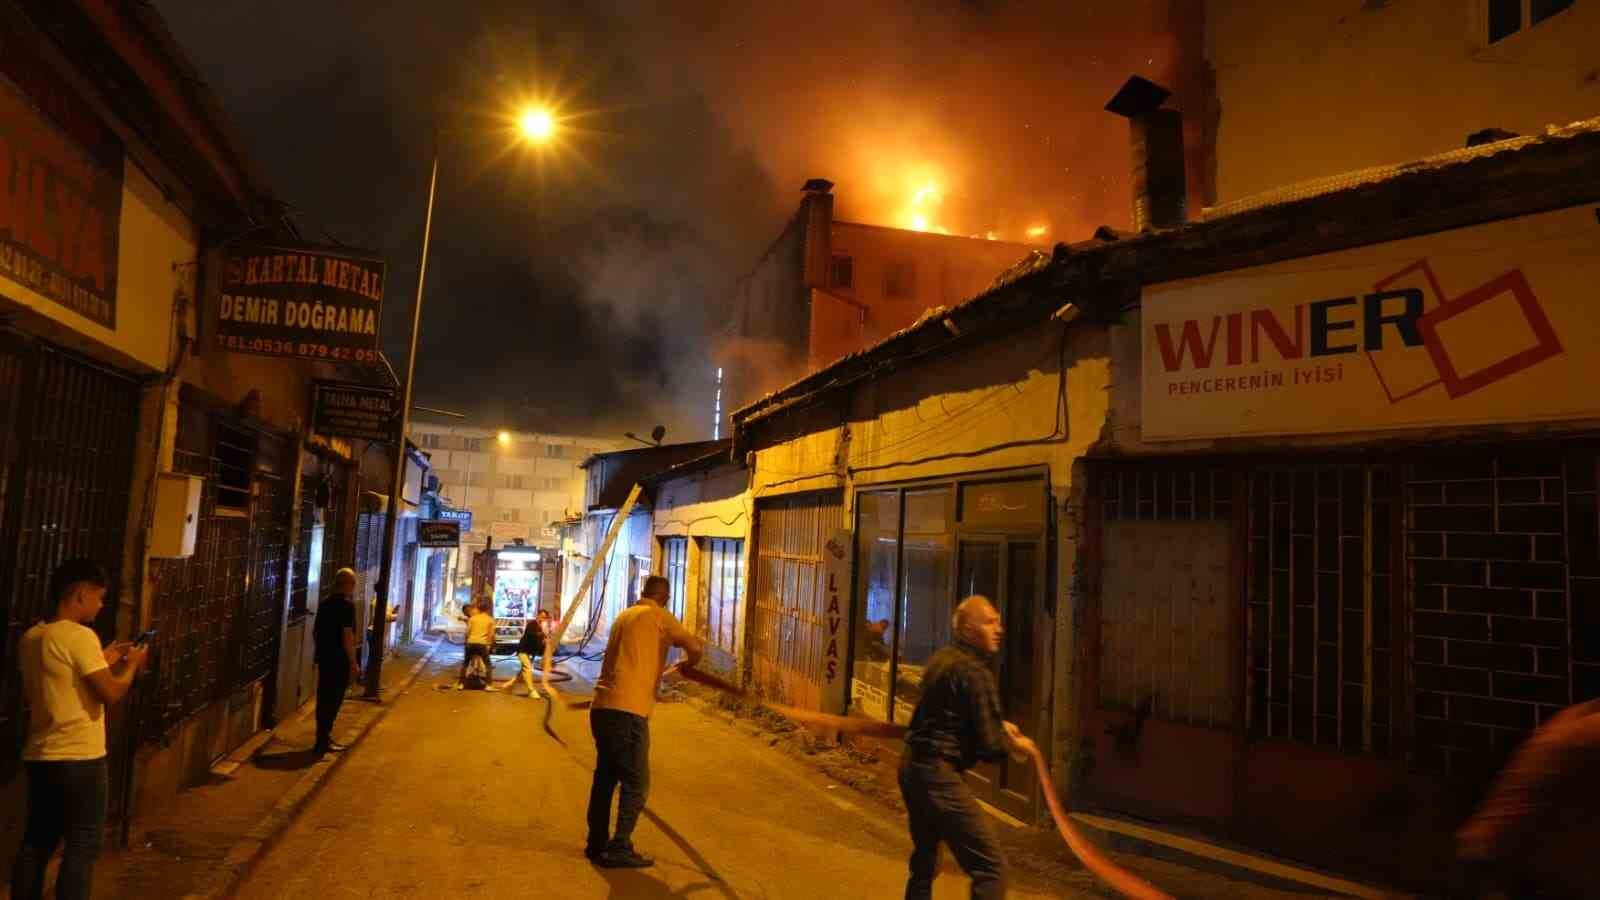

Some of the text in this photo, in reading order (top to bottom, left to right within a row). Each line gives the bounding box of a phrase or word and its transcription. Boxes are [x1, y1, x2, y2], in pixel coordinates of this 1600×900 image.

[245, 256, 380, 300] KARTAL METAL
[285, 301, 376, 335] DOĞRAMA
[1153, 288, 1424, 372] WINER
[333, 347, 352, 360] 42
[1294, 364, 1344, 385] İYİSİ
[827, 573, 840, 684] LAVAŞ
